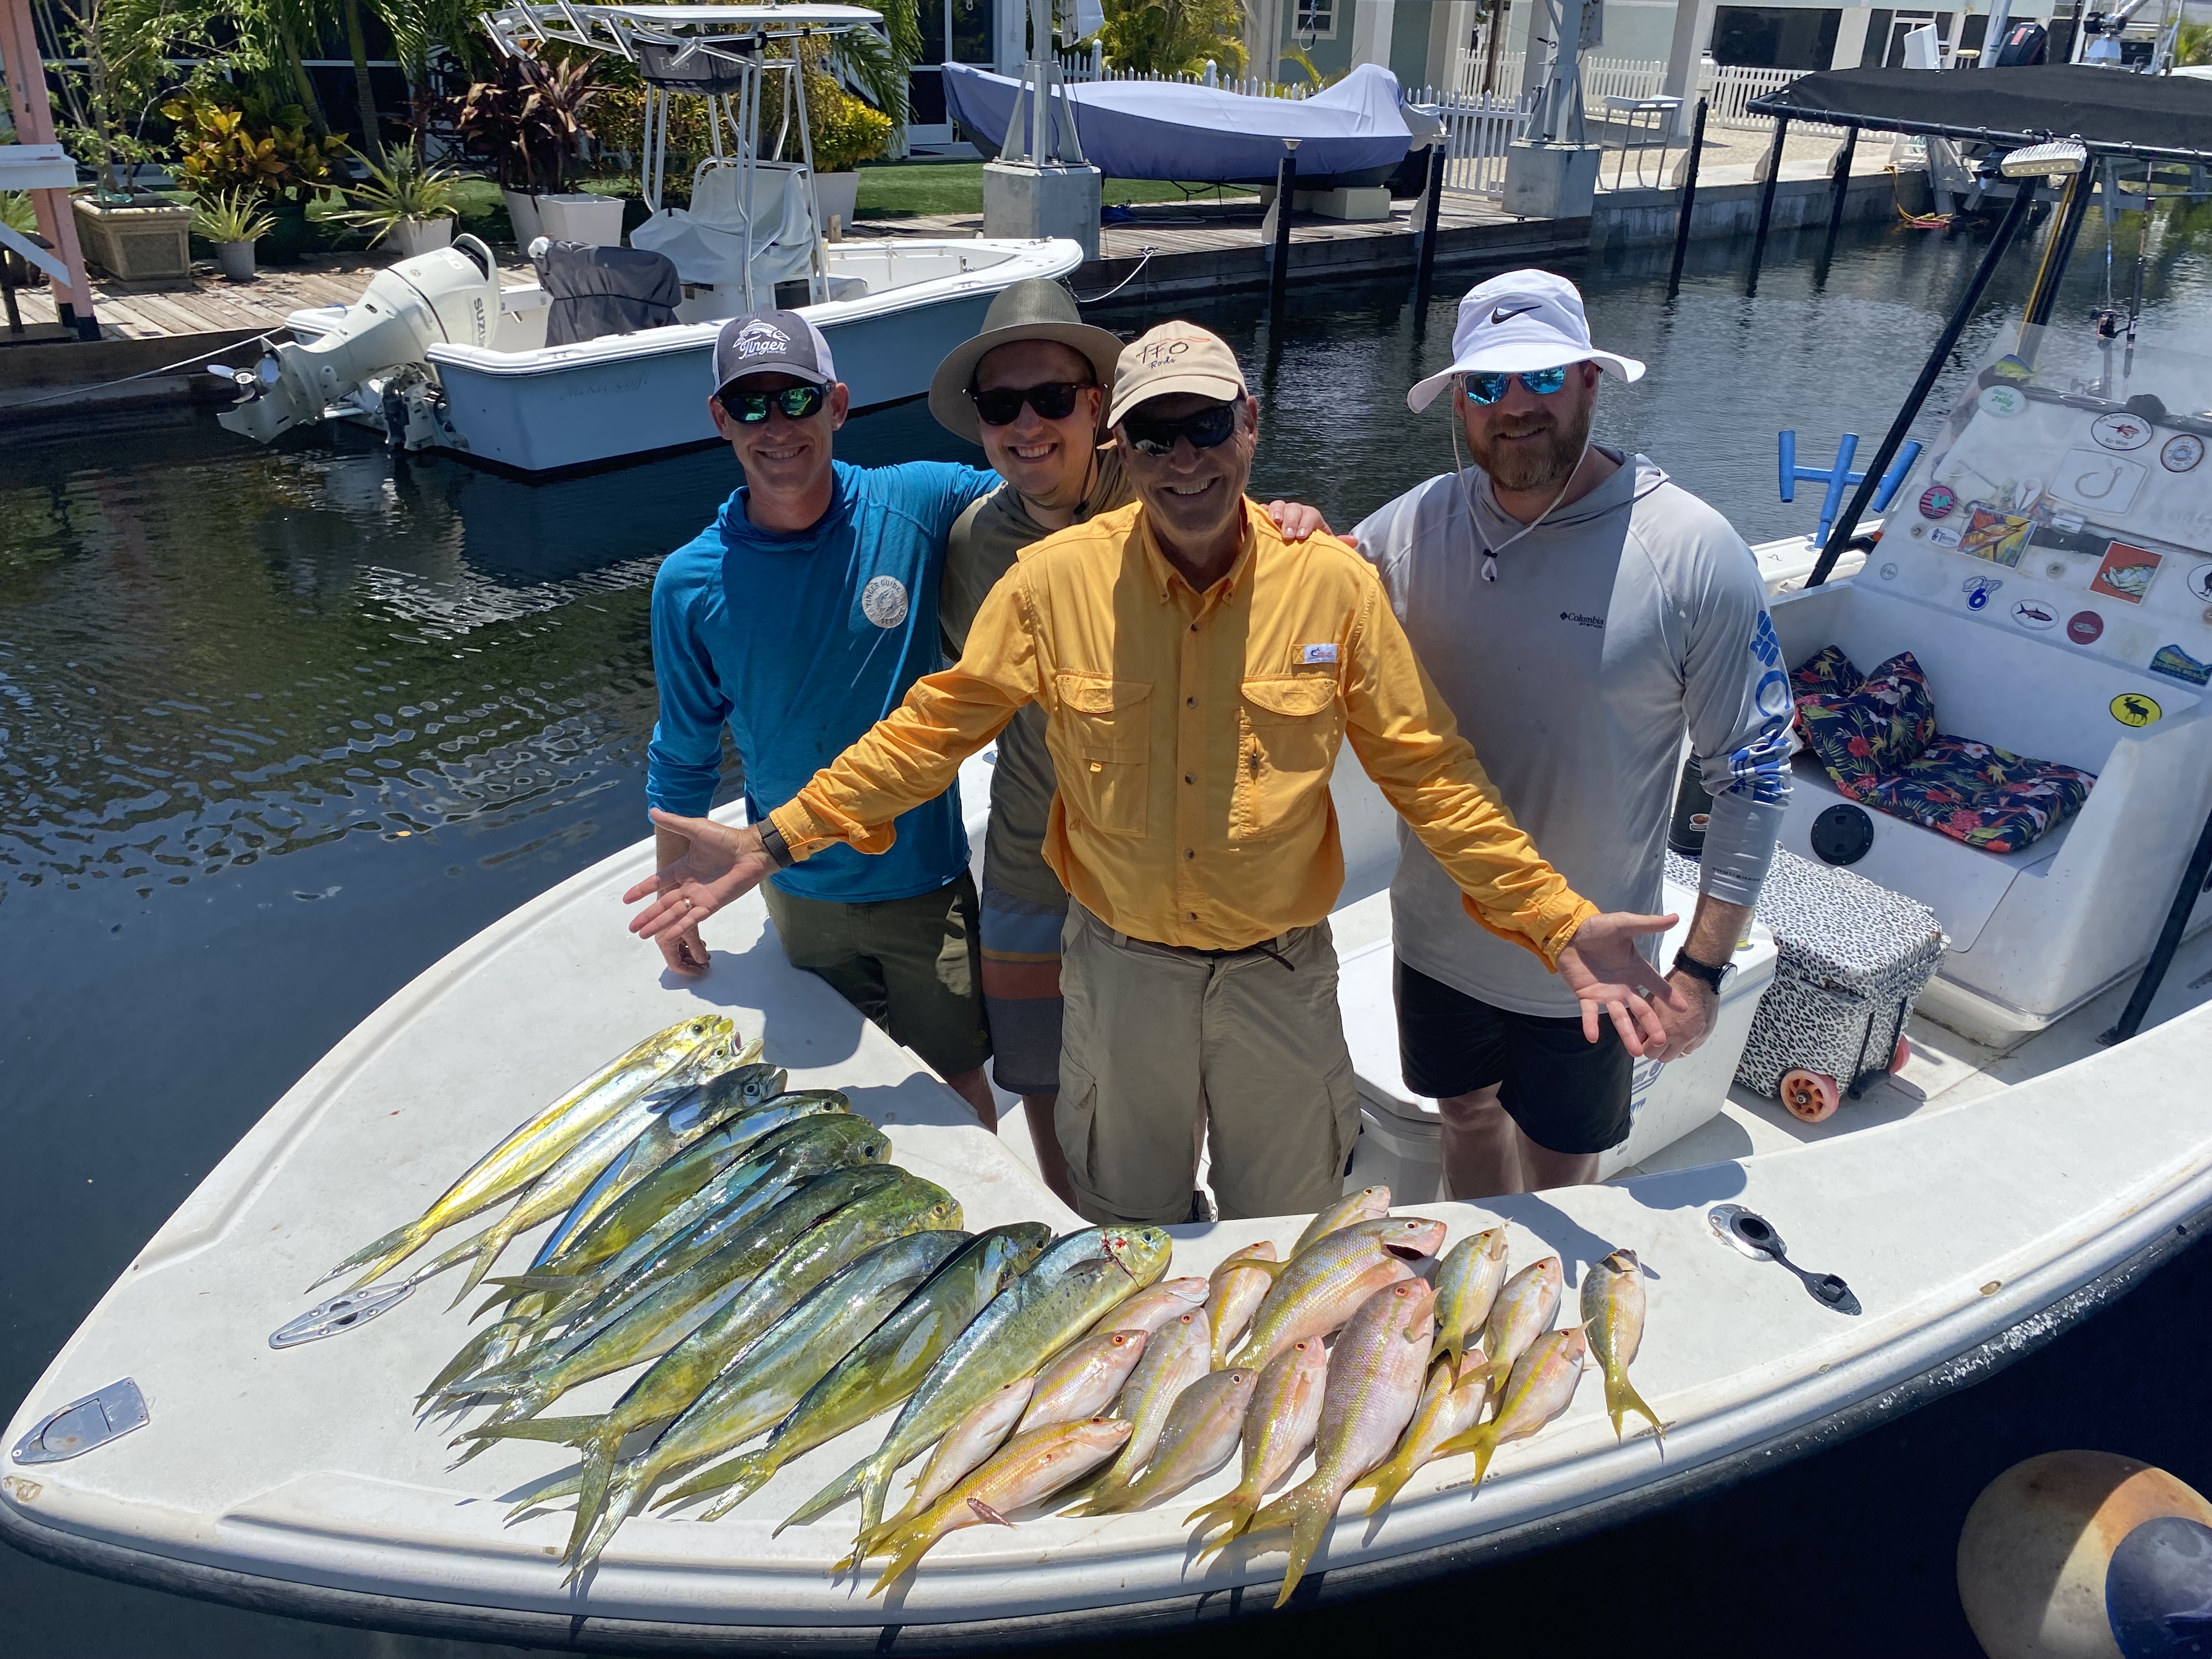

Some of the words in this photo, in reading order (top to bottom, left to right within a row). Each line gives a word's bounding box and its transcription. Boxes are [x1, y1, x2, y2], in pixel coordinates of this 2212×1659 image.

[474, 297, 486, 347] SUZUK
[738, 334, 787, 359] Tinger
[1136, 341, 1189, 364] TFO
[866, 582, 879, 607] TINGER
[881, 579, 901, 592] GUIDE
[881, 607, 906, 625] SERVICE
[1568, 612, 1604, 625] Columbia
